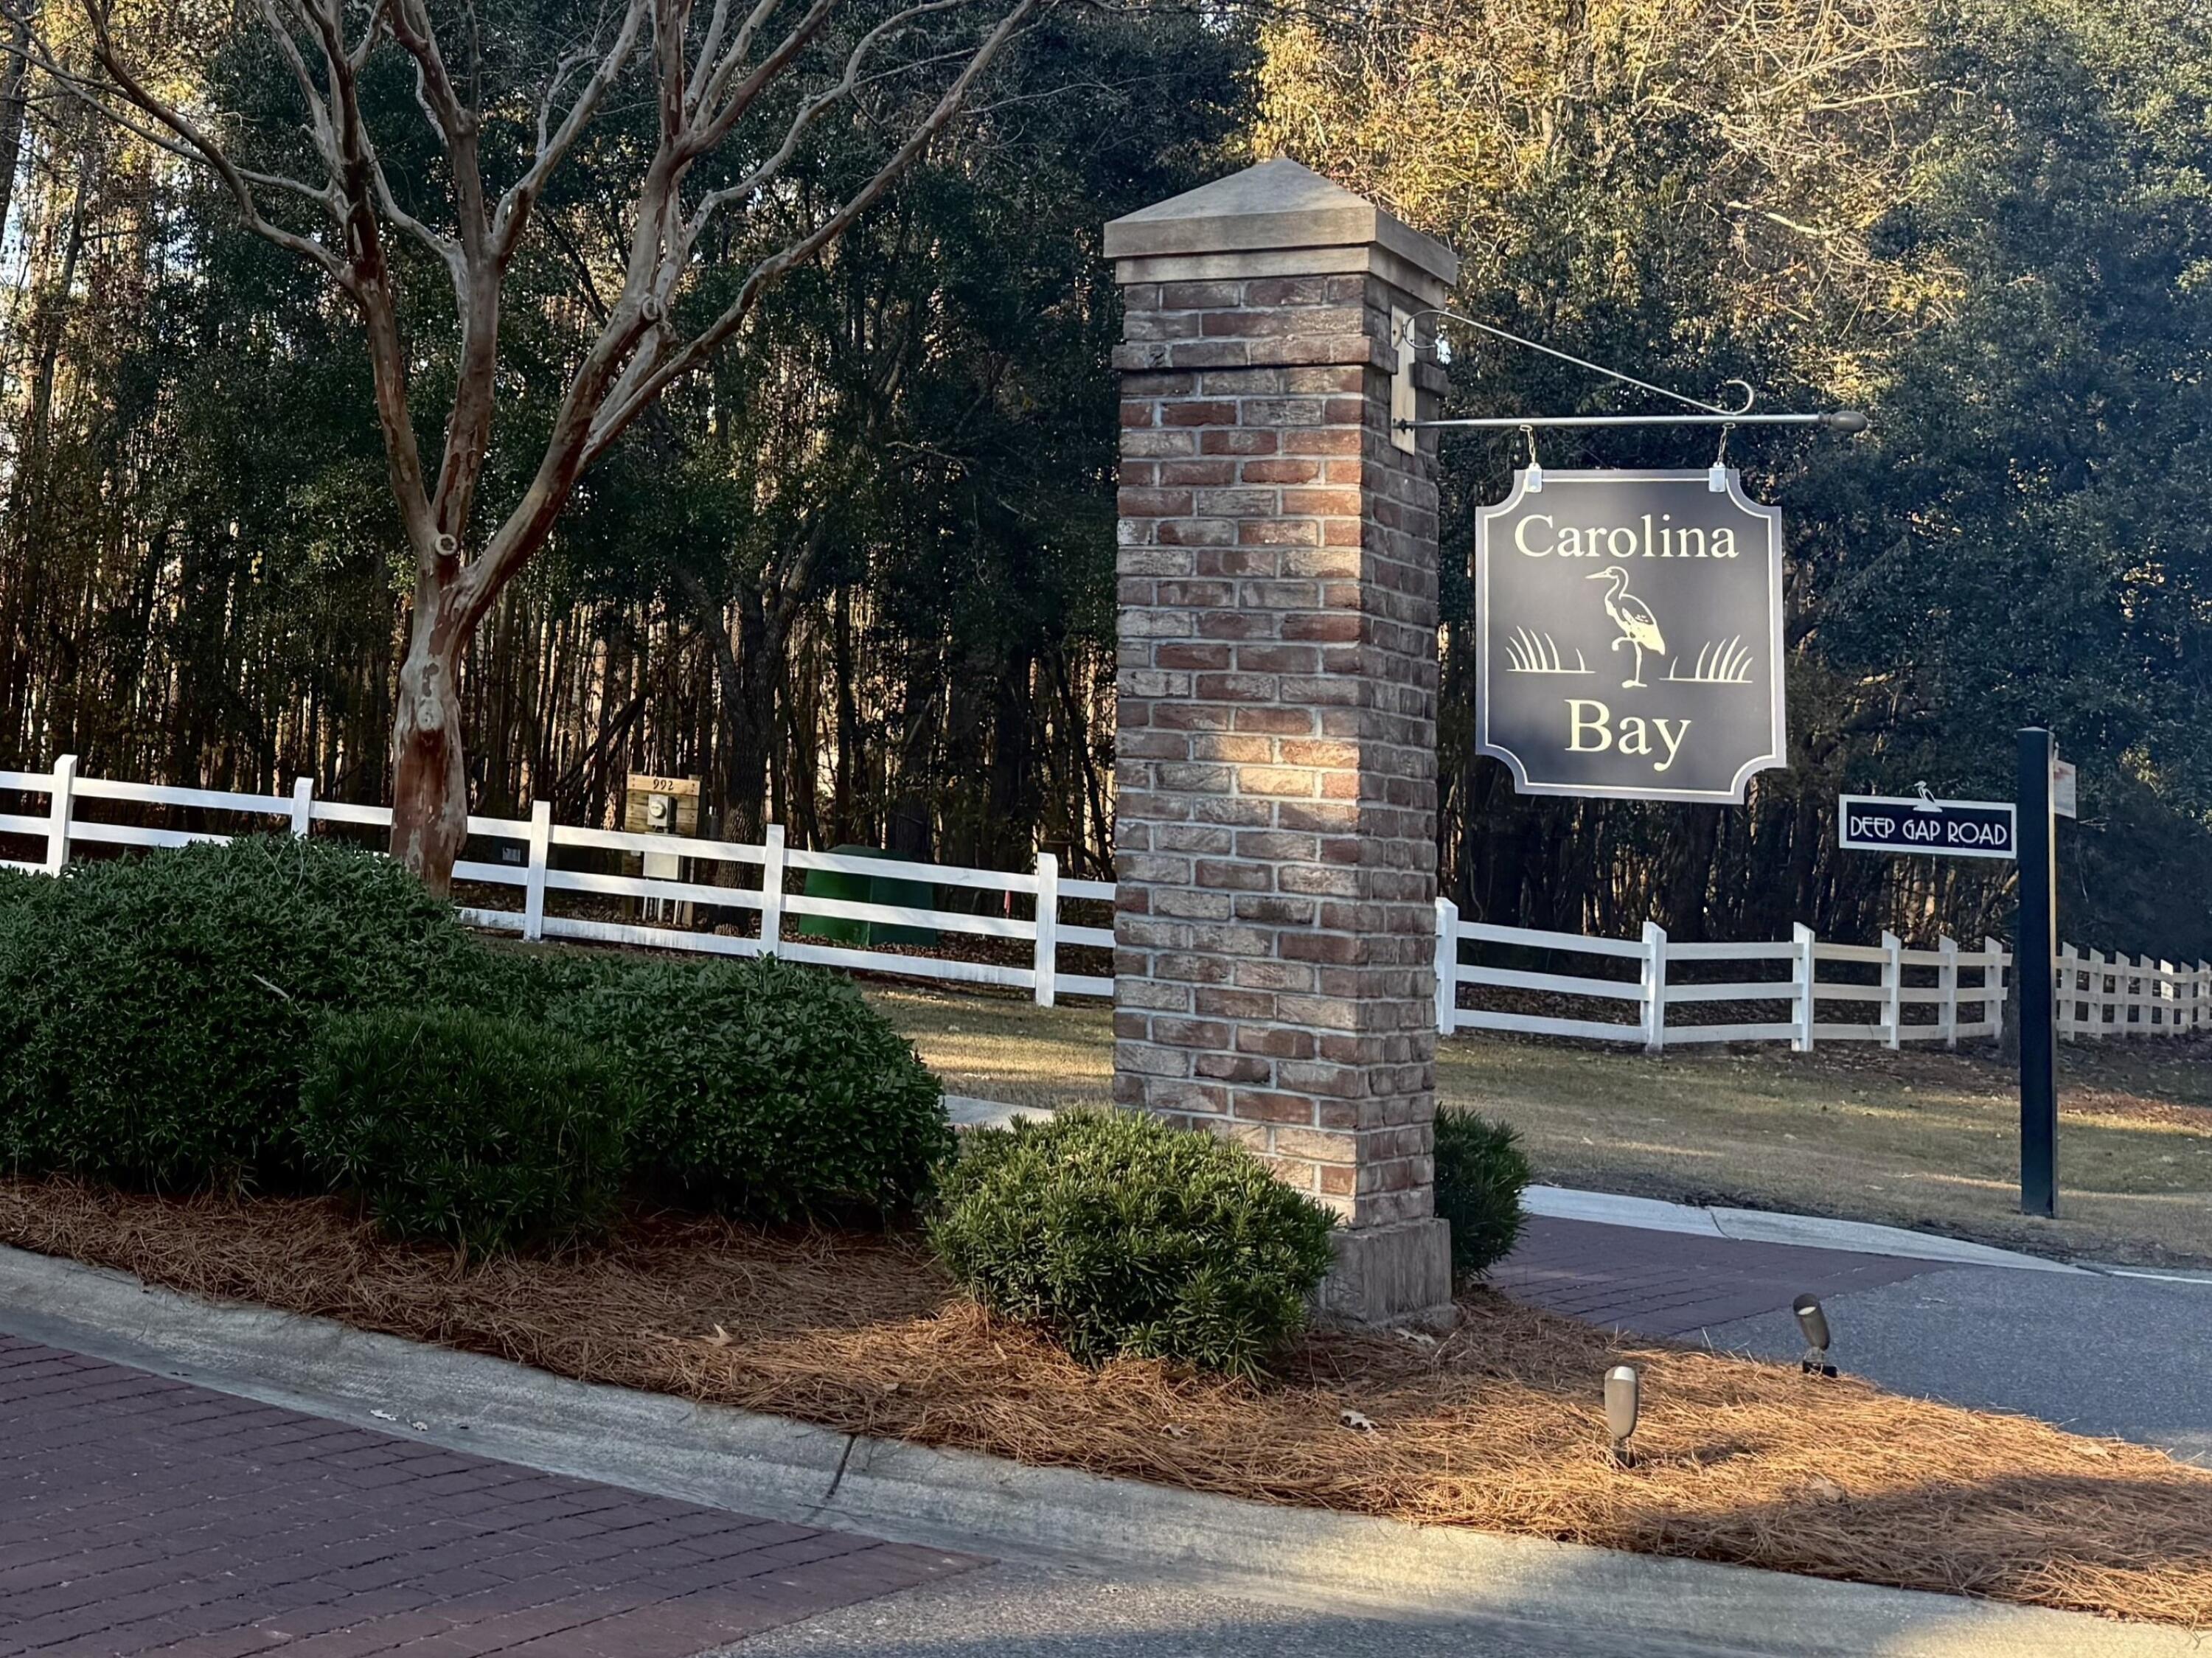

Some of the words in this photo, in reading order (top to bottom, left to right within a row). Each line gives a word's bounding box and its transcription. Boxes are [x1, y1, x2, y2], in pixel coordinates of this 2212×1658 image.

[1514, 514, 1739, 557] Carolina
[1564, 699, 1691, 772] Bay
[653, 779, 674, 791] 992
[1851, 816, 1895, 838] DEEP
[1902, 819, 1941, 841] GAP
[1947, 822, 2007, 845] ROAD
